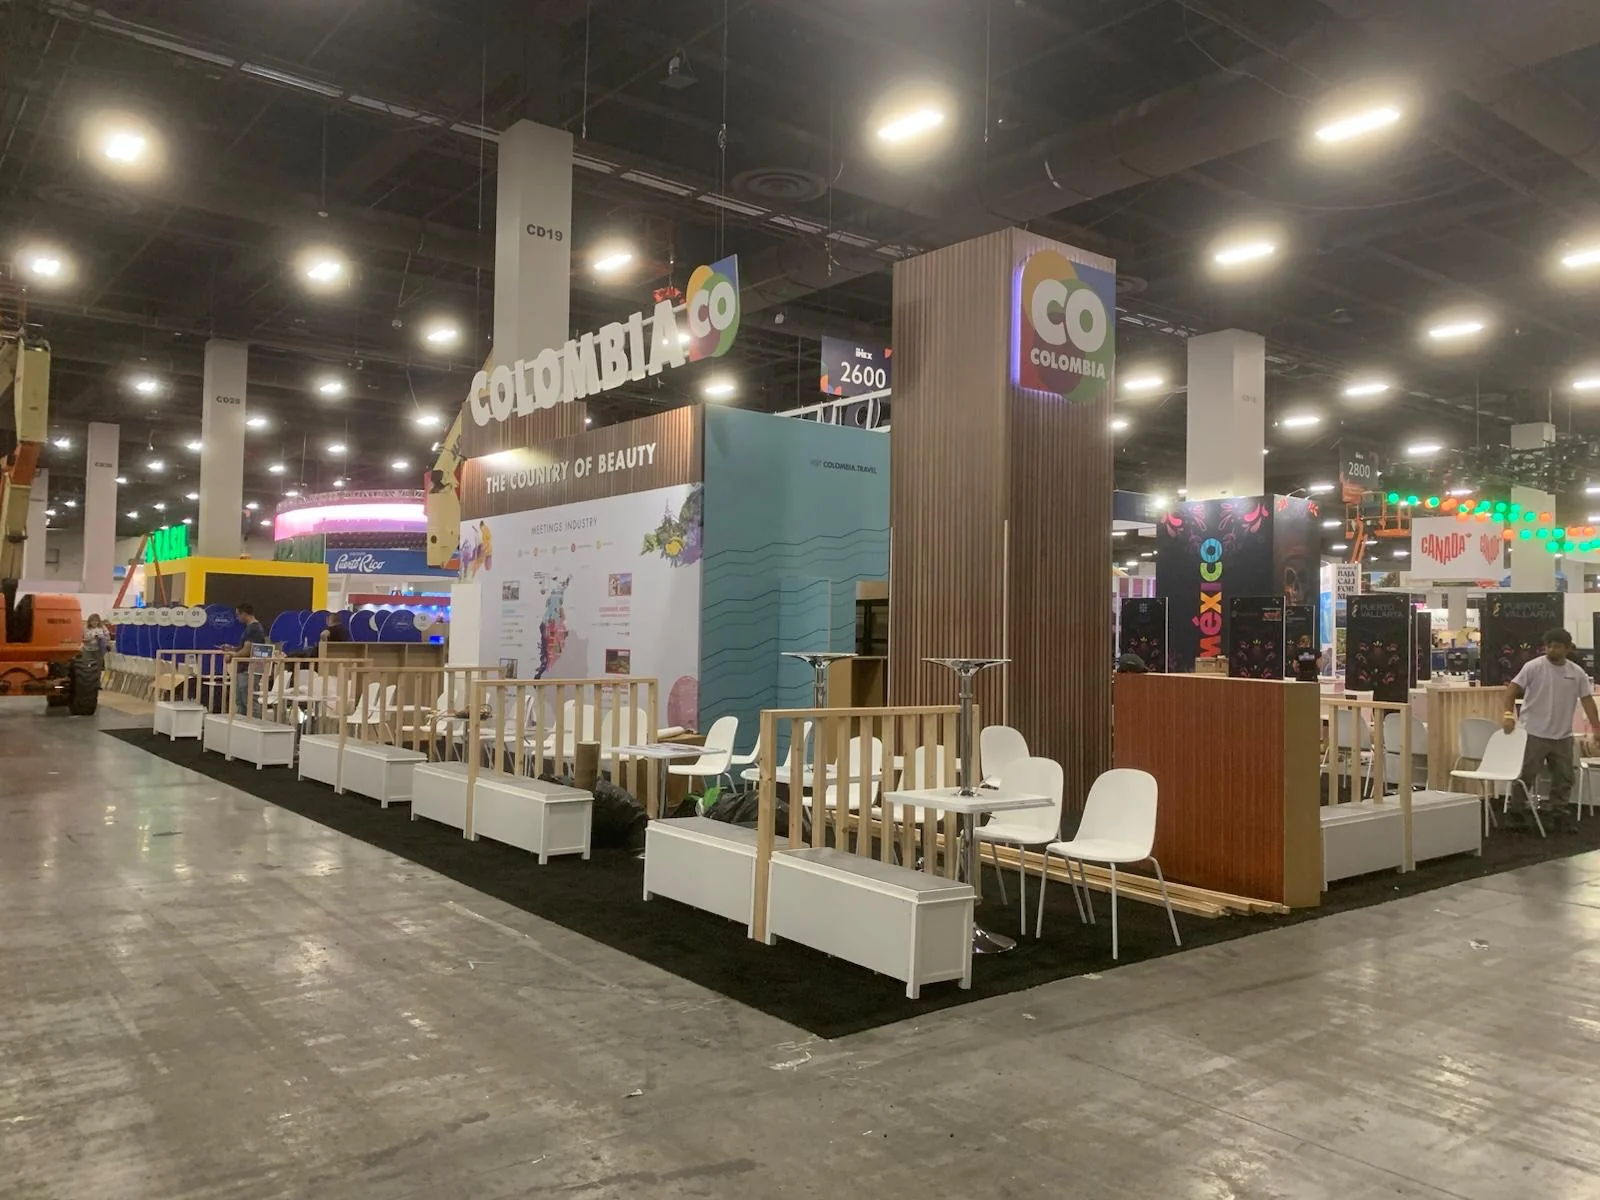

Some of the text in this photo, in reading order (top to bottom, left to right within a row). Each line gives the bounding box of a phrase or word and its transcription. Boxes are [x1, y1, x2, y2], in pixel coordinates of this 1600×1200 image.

[526, 224, 563, 241] CD19
[692, 281, 736, 338] CO
[1031, 278, 1107, 352] CO
[470, 299, 686, 427] COLOMBIA
[840, 361, 886, 389] 2600
[1030, 348, 1106, 380] COLOMBIA
[486, 442, 657, 494] THE COUNTRY OF BEAUTY
[1348, 461, 1370, 479] 2800
[531, 517, 598, 535] MEETINGS INDUSTRY
[359, 553, 386, 573] Rico
[1421, 533, 1465, 565] CANADA
